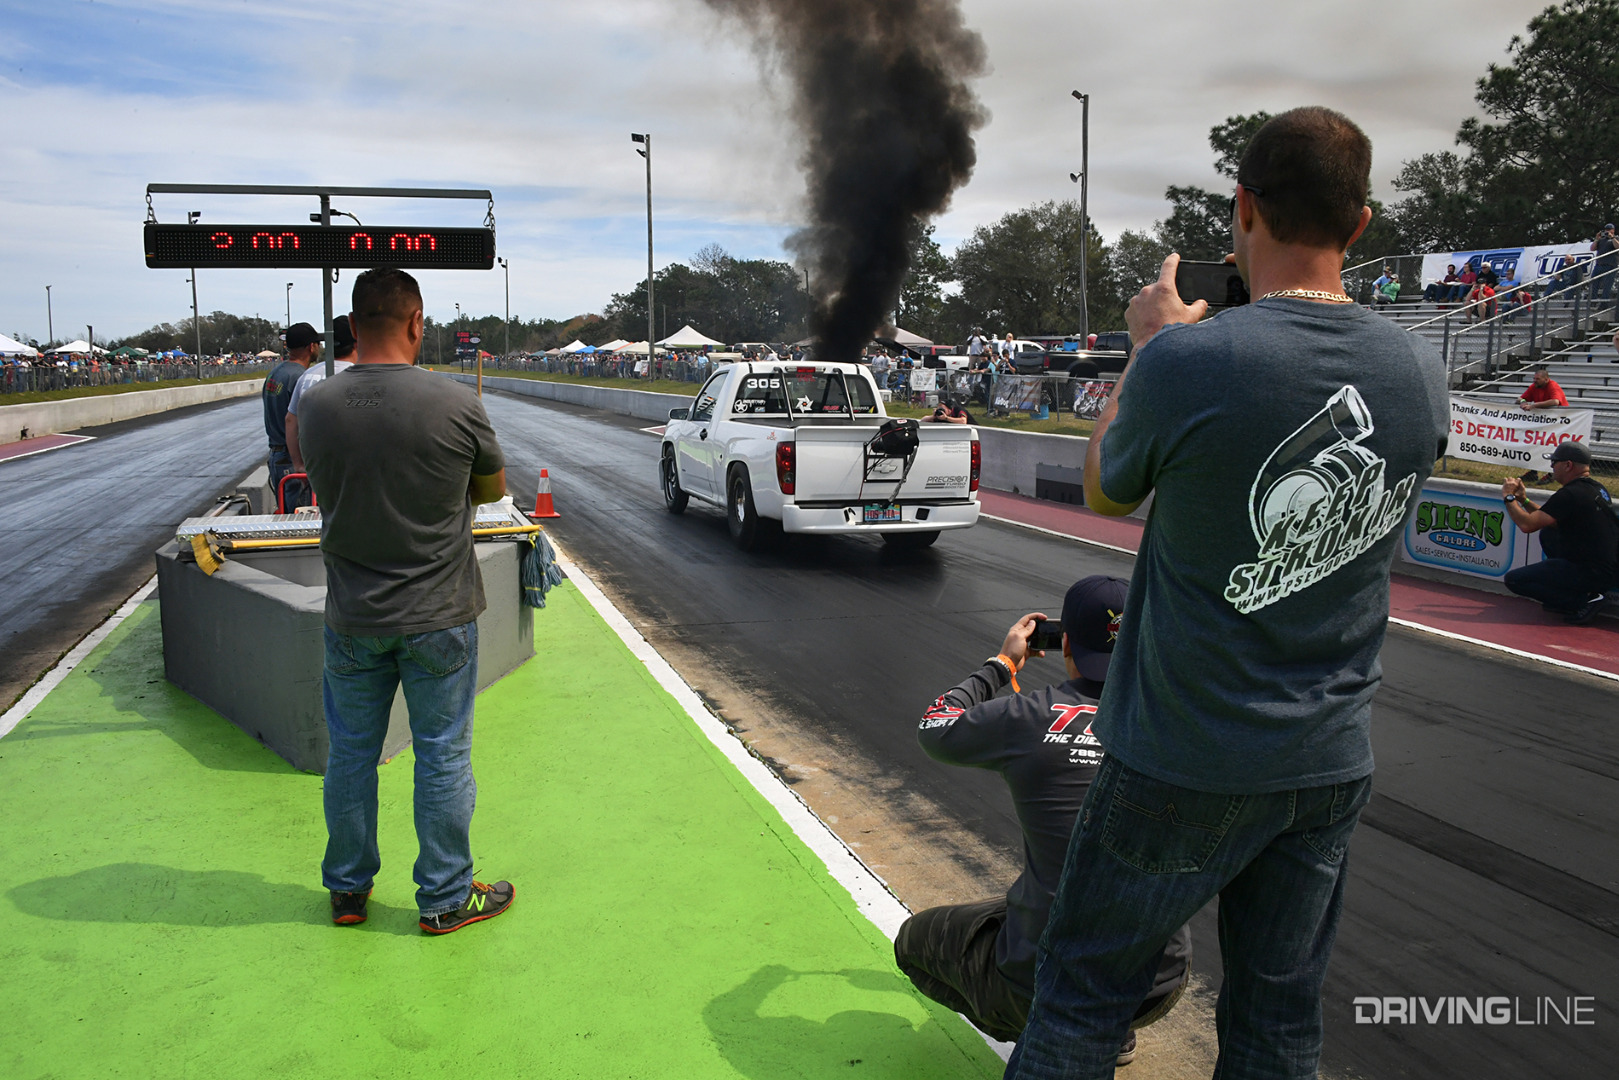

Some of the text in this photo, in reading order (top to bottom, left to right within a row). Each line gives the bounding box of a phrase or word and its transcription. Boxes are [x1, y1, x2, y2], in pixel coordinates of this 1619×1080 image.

[746, 378, 780, 389] 305
[1452, 403, 1571, 425] Thanks And Appreciation To
[1450, 419, 1464, 434] 'S
[1467, 421, 1519, 443] DETAIL
[1460, 441, 1532, 462] 850-689-AUTO
[926, 475, 968, 483] PRECISION
[1260, 460, 1384, 556] KEEP
[1416, 501, 1504, 547] SIGNS
[1436, 534, 1476, 548] GALORE
[1048, 703, 1098, 736] T
[1043, 733, 1072, 744] THE
[1069, 758, 1102, 766] www.
